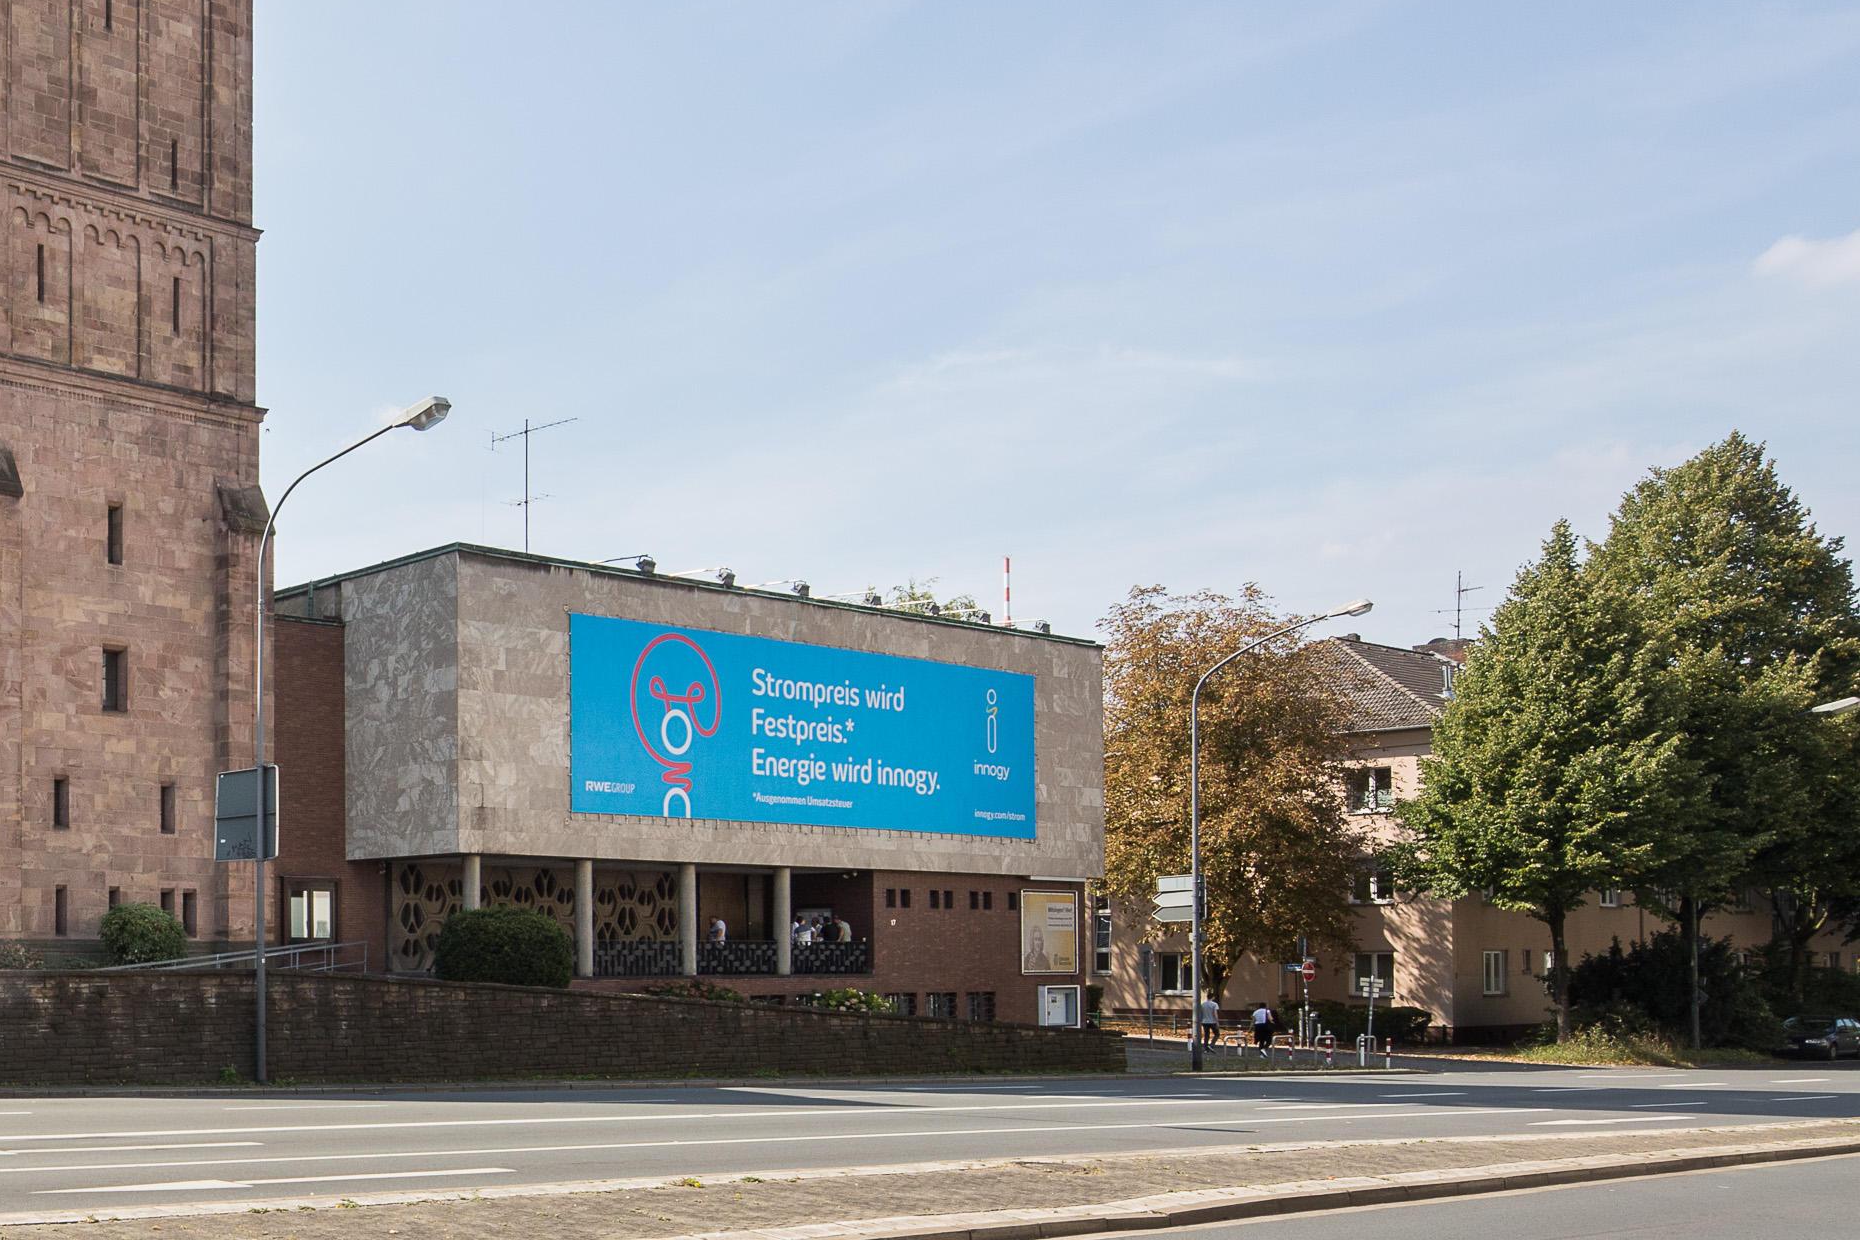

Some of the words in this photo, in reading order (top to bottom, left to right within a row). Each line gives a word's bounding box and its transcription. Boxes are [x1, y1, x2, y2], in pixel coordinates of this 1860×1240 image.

[752, 668, 860, 709] Strompreis
[865, 684, 905, 712] wird
[752, 747, 826, 786] Energie
[831, 756, 873, 785] wird
[877, 759, 941, 796] innogy.
[973, 759, 1010, 781] innogy
[807, 795, 853, 808] Umsatzsteuer
[974, 809, 1026, 821] innogy.com/strom
